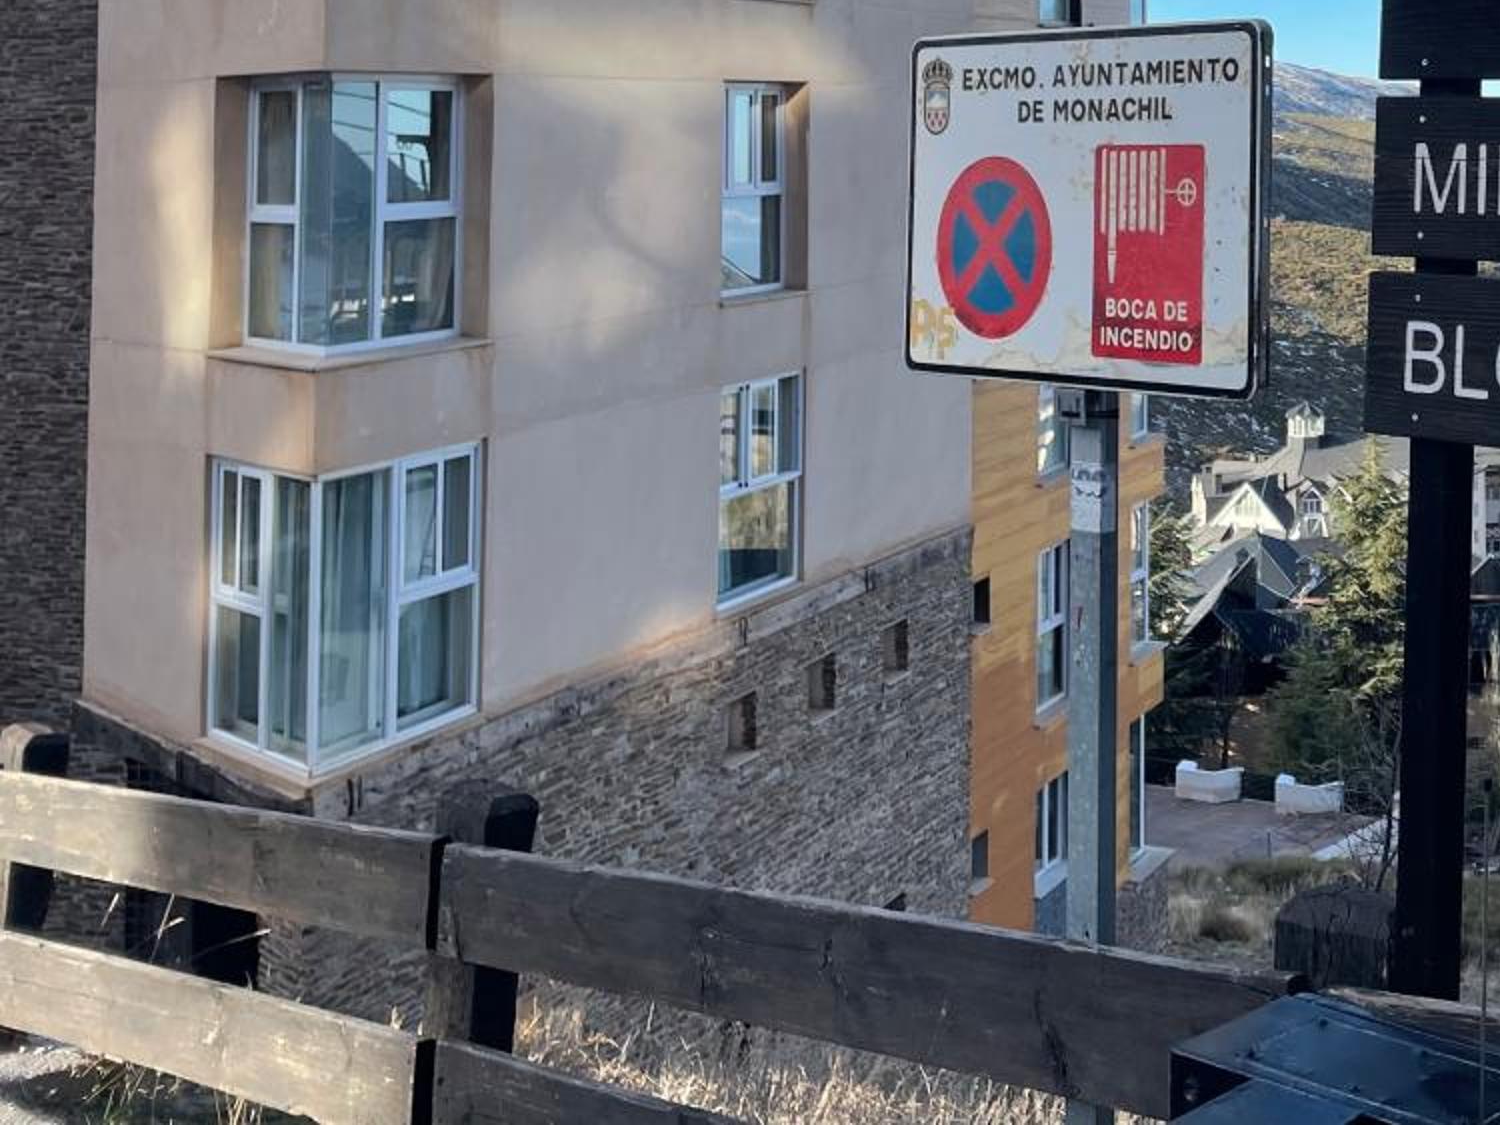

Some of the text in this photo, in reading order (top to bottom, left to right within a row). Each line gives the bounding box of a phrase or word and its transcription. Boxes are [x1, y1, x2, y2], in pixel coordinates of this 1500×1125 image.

[962, 58, 1239, 91] EXCMO. AYUNTAMIENTO
[1017, 97, 1173, 123] DE MONACHIL
[1105, 298, 1188, 322] BOCA DE
[1100, 326, 1193, 352] INCENDIO
